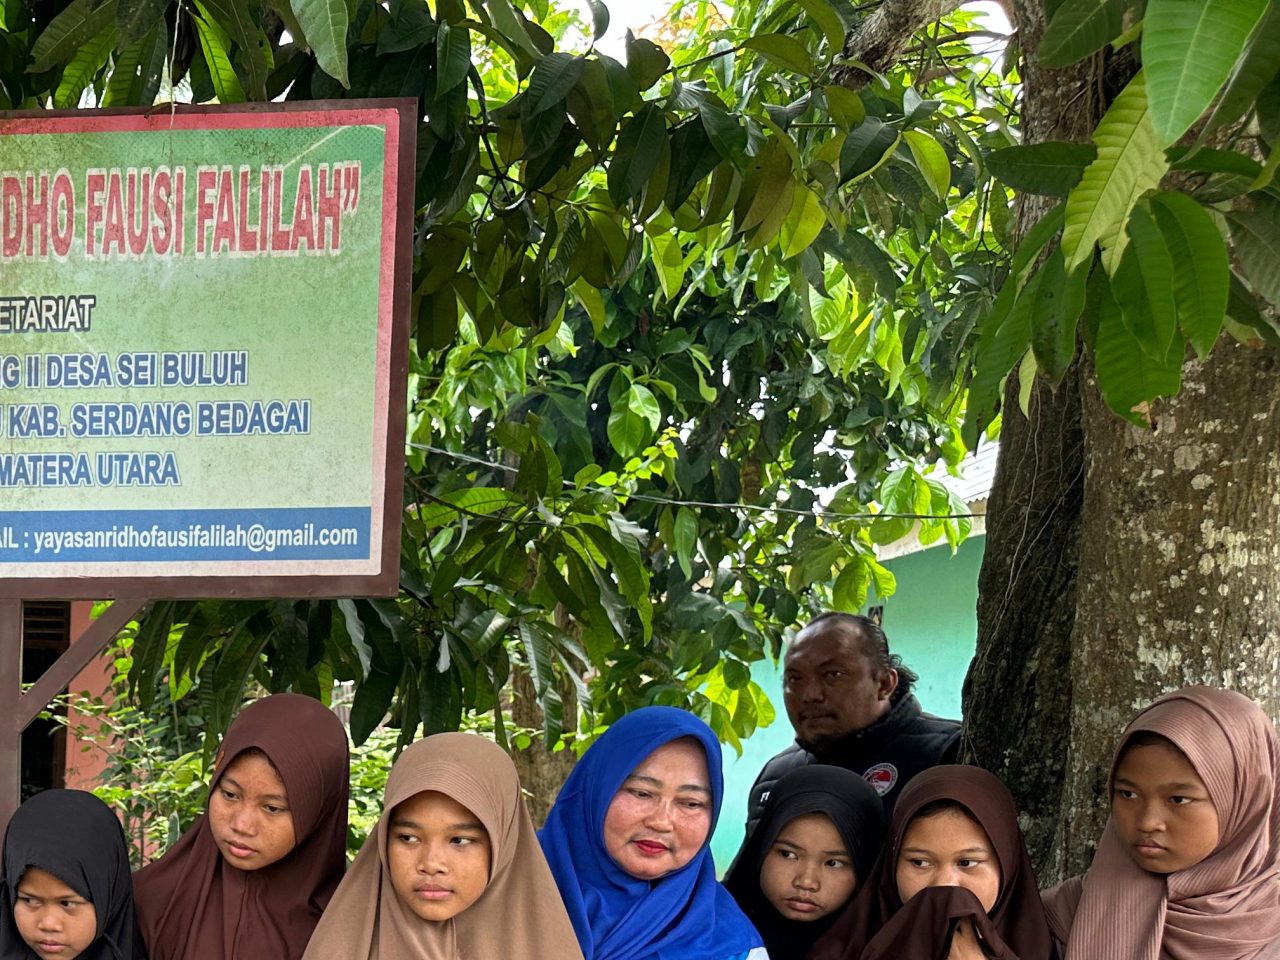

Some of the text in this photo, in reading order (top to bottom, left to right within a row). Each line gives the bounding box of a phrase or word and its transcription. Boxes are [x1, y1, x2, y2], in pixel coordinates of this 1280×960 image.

[85, 167, 184, 256] FAUSI
[26, 355, 40, 388] II
[46, 353, 112, 388] DESA
[117, 352, 156, 386] SEI
[162, 351, 248, 386] BULUH
[8, 403, 65, 437] KAB.
[72, 402, 192, 437] SERDANG
[196, 400, 310, 436] BEDAGAI
[96, 451, 181, 486] UTARA
[34, 523, 358, 553] yayasanridhofausifalilah@gmail.com
